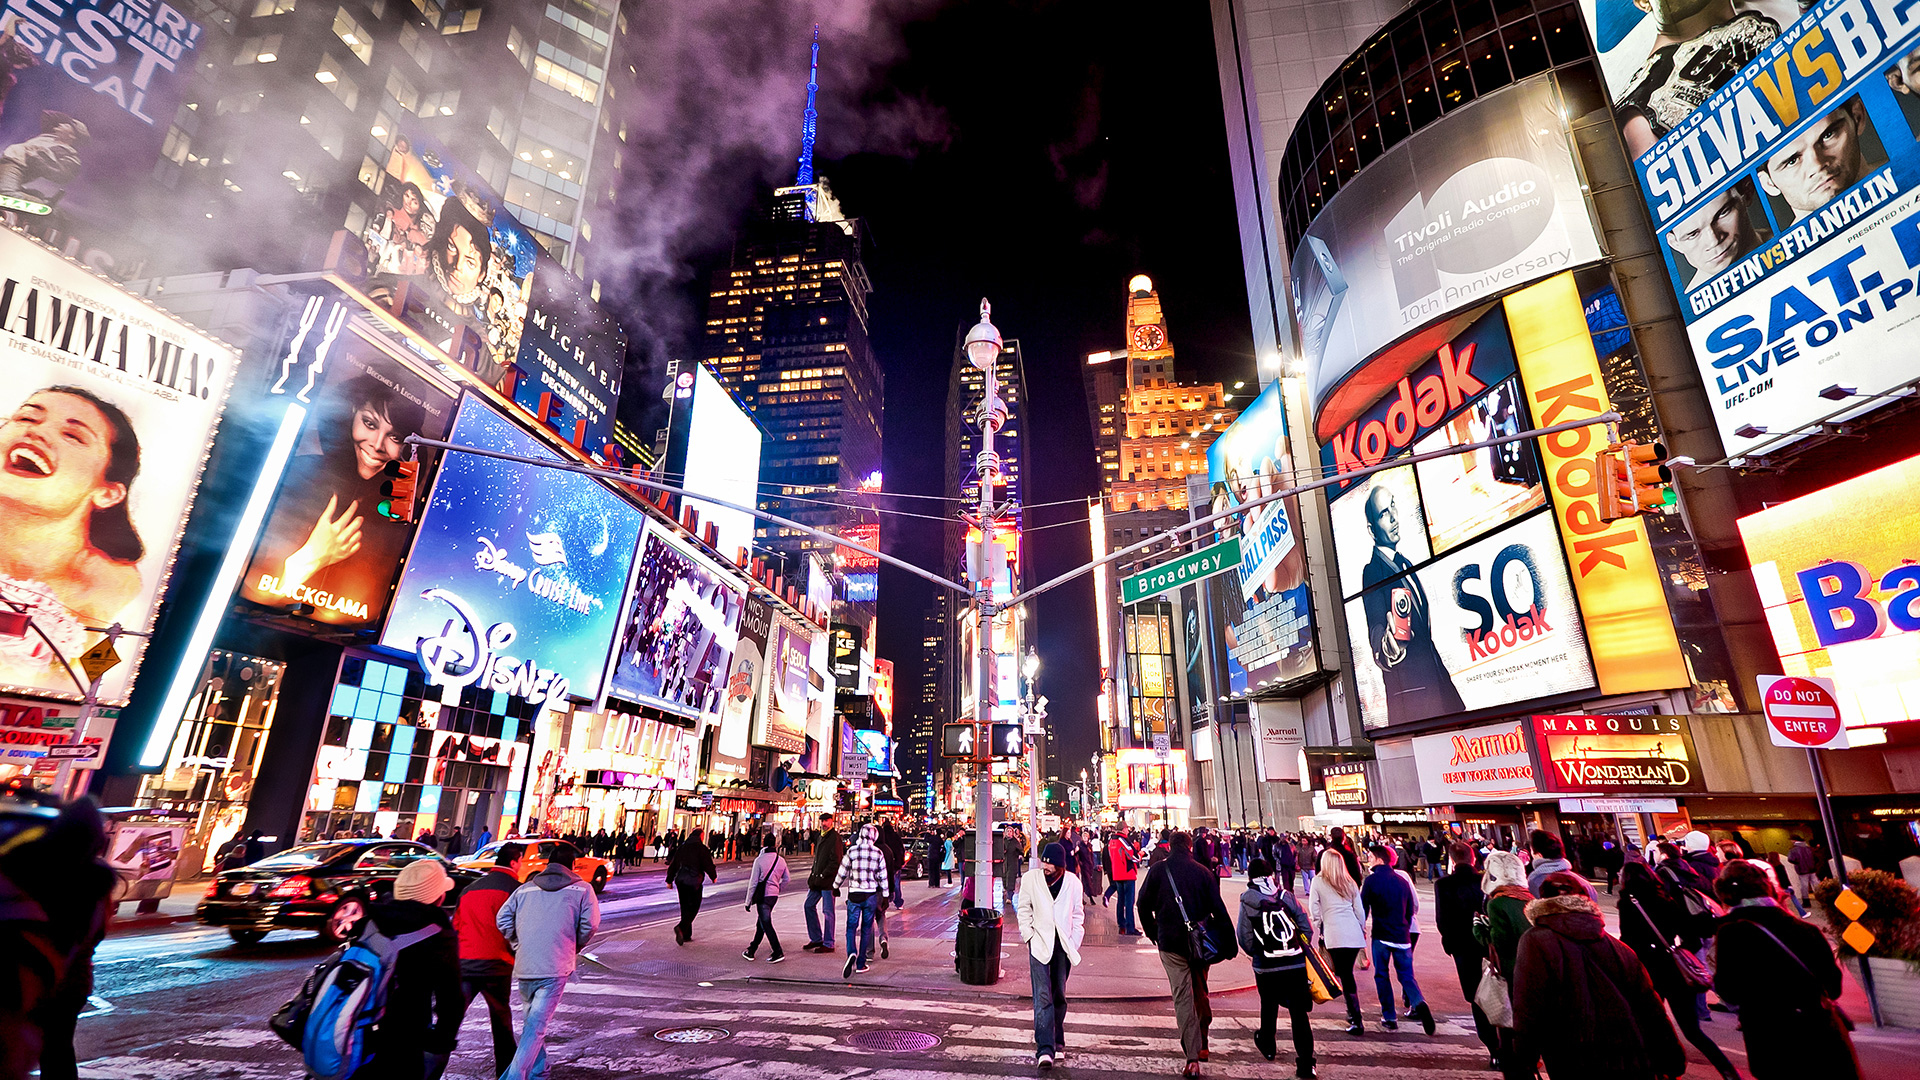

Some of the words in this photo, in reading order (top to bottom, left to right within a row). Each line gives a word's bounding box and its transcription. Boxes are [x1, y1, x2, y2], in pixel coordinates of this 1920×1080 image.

[108, 2, 183, 60] AWARD
[1641, 111, 1705, 166] WORLD
[1646, 85, 1782, 222] SILVA
[1752, 25, 1842, 128] VS
[1394, 210, 1453, 253] Tivoli
[1461, 180, 1537, 221] Audio
[1396, 253, 1414, 267] The
[1415, 233, 1451, 256] Original
[1453, 218, 1484, 237] Radio
[1486, 196, 1541, 222] Company
[1689, 253, 1765, 316] GRIFFIN
[1760, 243, 1787, 270] VS
[1778, 168, 1899, 260] FRANKLIN
[1847, 210, 1897, 244] PRESENTED
[1899, 201, 1911, 213] BY
[1401, 298, 1440, 326] 10th
[1445, 248, 1571, 303] Anniversary
[1705, 244, 1884, 370] SAT.
[8, 337, 29, 352] THE
[31, 344, 65, 365] SMASH
[139, 333, 214, 400] MIA!
[532, 309, 618, 396] MICHAEL
[1715, 337, 1800, 396] LIVE
[1805, 299, 1875, 348] ON
[536, 347, 559, 373] THE
[557, 366, 580, 390] NEW
[578, 386, 608, 415] ALBUM
[541, 371, 588, 417] DECEMBER
[588, 411, 599, 424] 14
[1725, 377, 1774, 410] UFC.COM
[1332, 342, 1489, 488] Kodak
[1534, 373, 1639, 579] Kodak
[1138, 551, 1222, 594] Broadway
[1239, 542, 1263, 585] HALL
[1260, 508, 1288, 558] PASS
[257, 574, 369, 620] BLACKGLAMA
[1451, 543, 1548, 643] SO
[742, 610, 769, 639] AMOUS
[1466, 603, 1554, 662] Kodak
[790, 647, 808, 671] SEOUL
[1466, 673, 1483, 684] SHARE
[1483, 669, 1498, 679] YOUR
[1505, 664, 1524, 674] KODAK
[1550, 653, 1568, 664] HERE
[1774, 689, 1792, 702] DO
[1796, 690, 1821, 702] NOT
[601, 709, 684, 761] FOREVER
[1266, 728, 1297, 736] Marriott
[1450, 725, 1528, 767] Marriot
[1542, 718, 1681, 732] MARQUIS
[1784, 720, 1827, 734] ENTER
[1323, 763, 1365, 776] MARQUIS
[1443, 772, 1466, 784] NEW
[1466, 769, 1498, 782] YORK
[1498, 765, 1534, 780] MARQ
[1555, 761, 1690, 785] WONDERLAND
